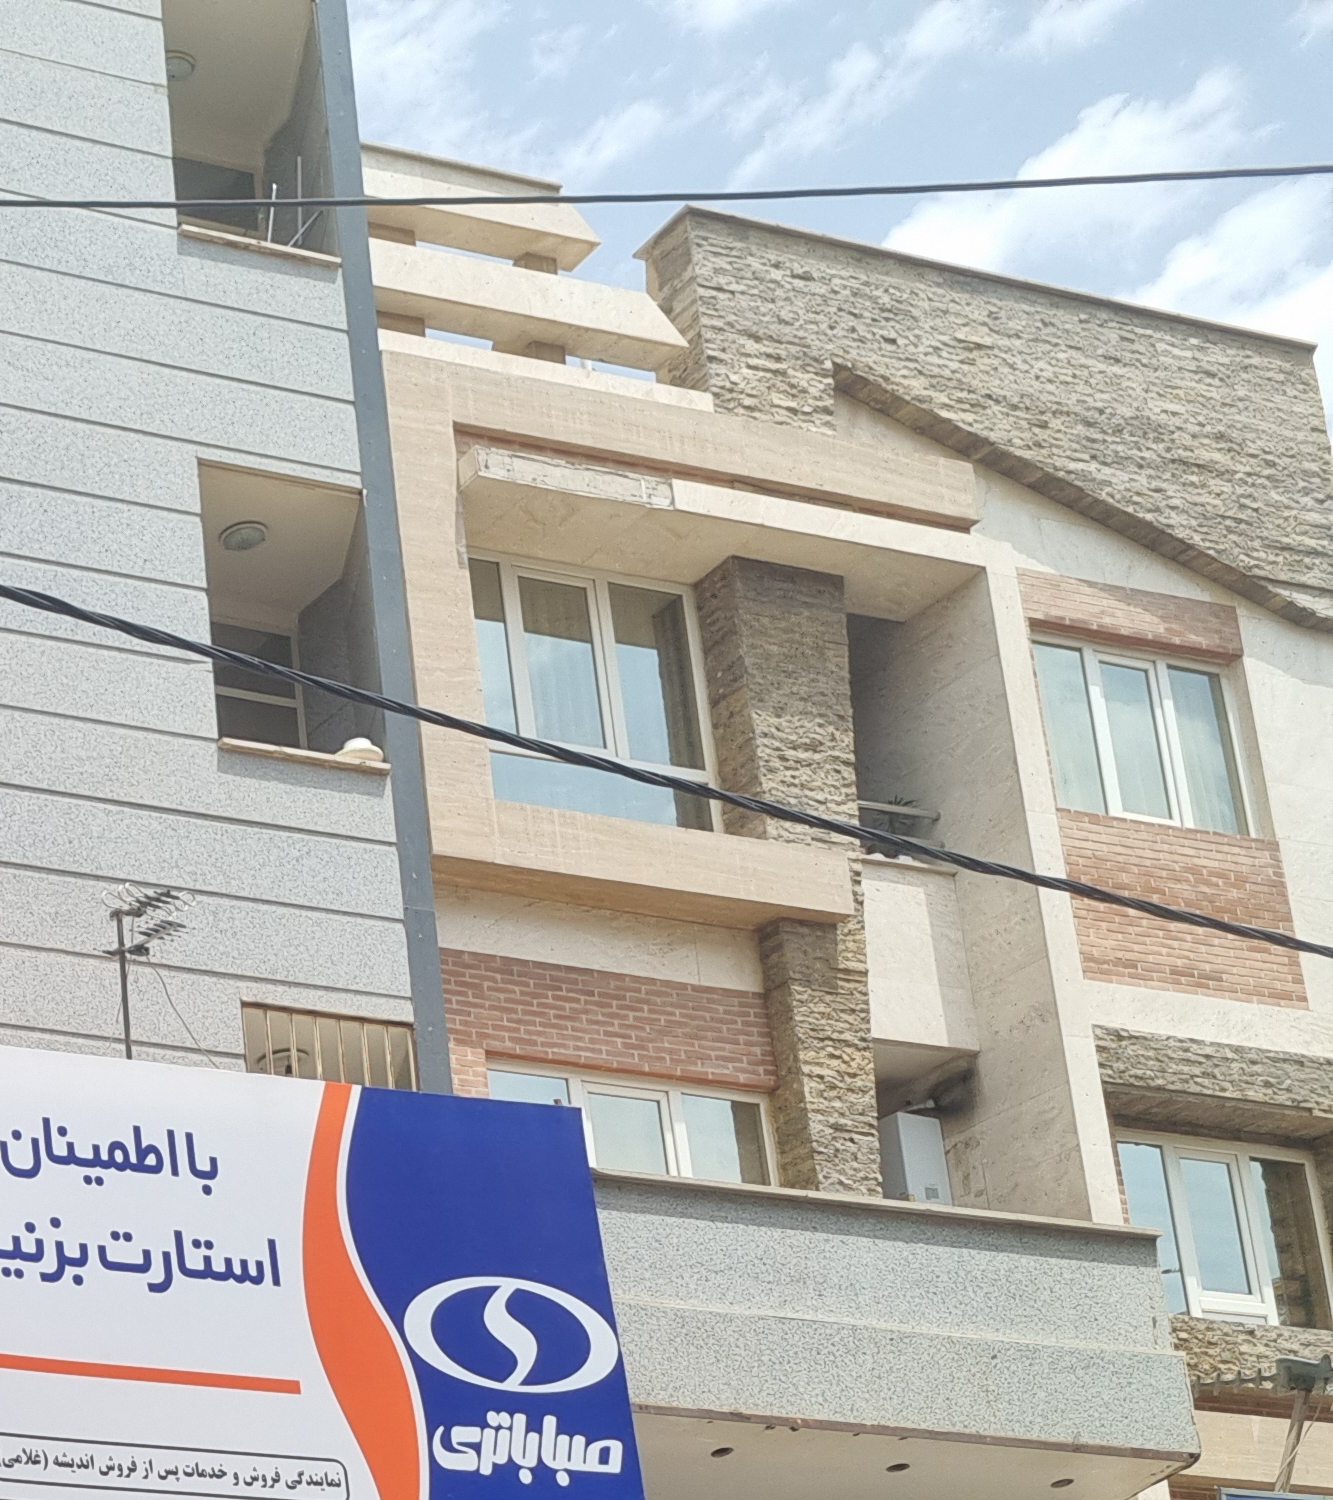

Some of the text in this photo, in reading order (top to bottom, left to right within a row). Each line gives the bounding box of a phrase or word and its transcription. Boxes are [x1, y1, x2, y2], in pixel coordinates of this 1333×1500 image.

[0, 1116, 219, 1196] با اطمینان
[97, 1229, 282, 1294] استارت
[52, 1453, 95, 1473] اندیشه
[98, 1454, 138, 1478] فروش
[141, 1456, 154, 1480] از
[157, 1462, 181, 1483] پس
[182, 1463, 228, 1483] خدمات
[233, 1473, 240, 1487] و
[242, 1466, 282, 1488] فروش
[284, 1473, 343, 1491] نمایندگی
